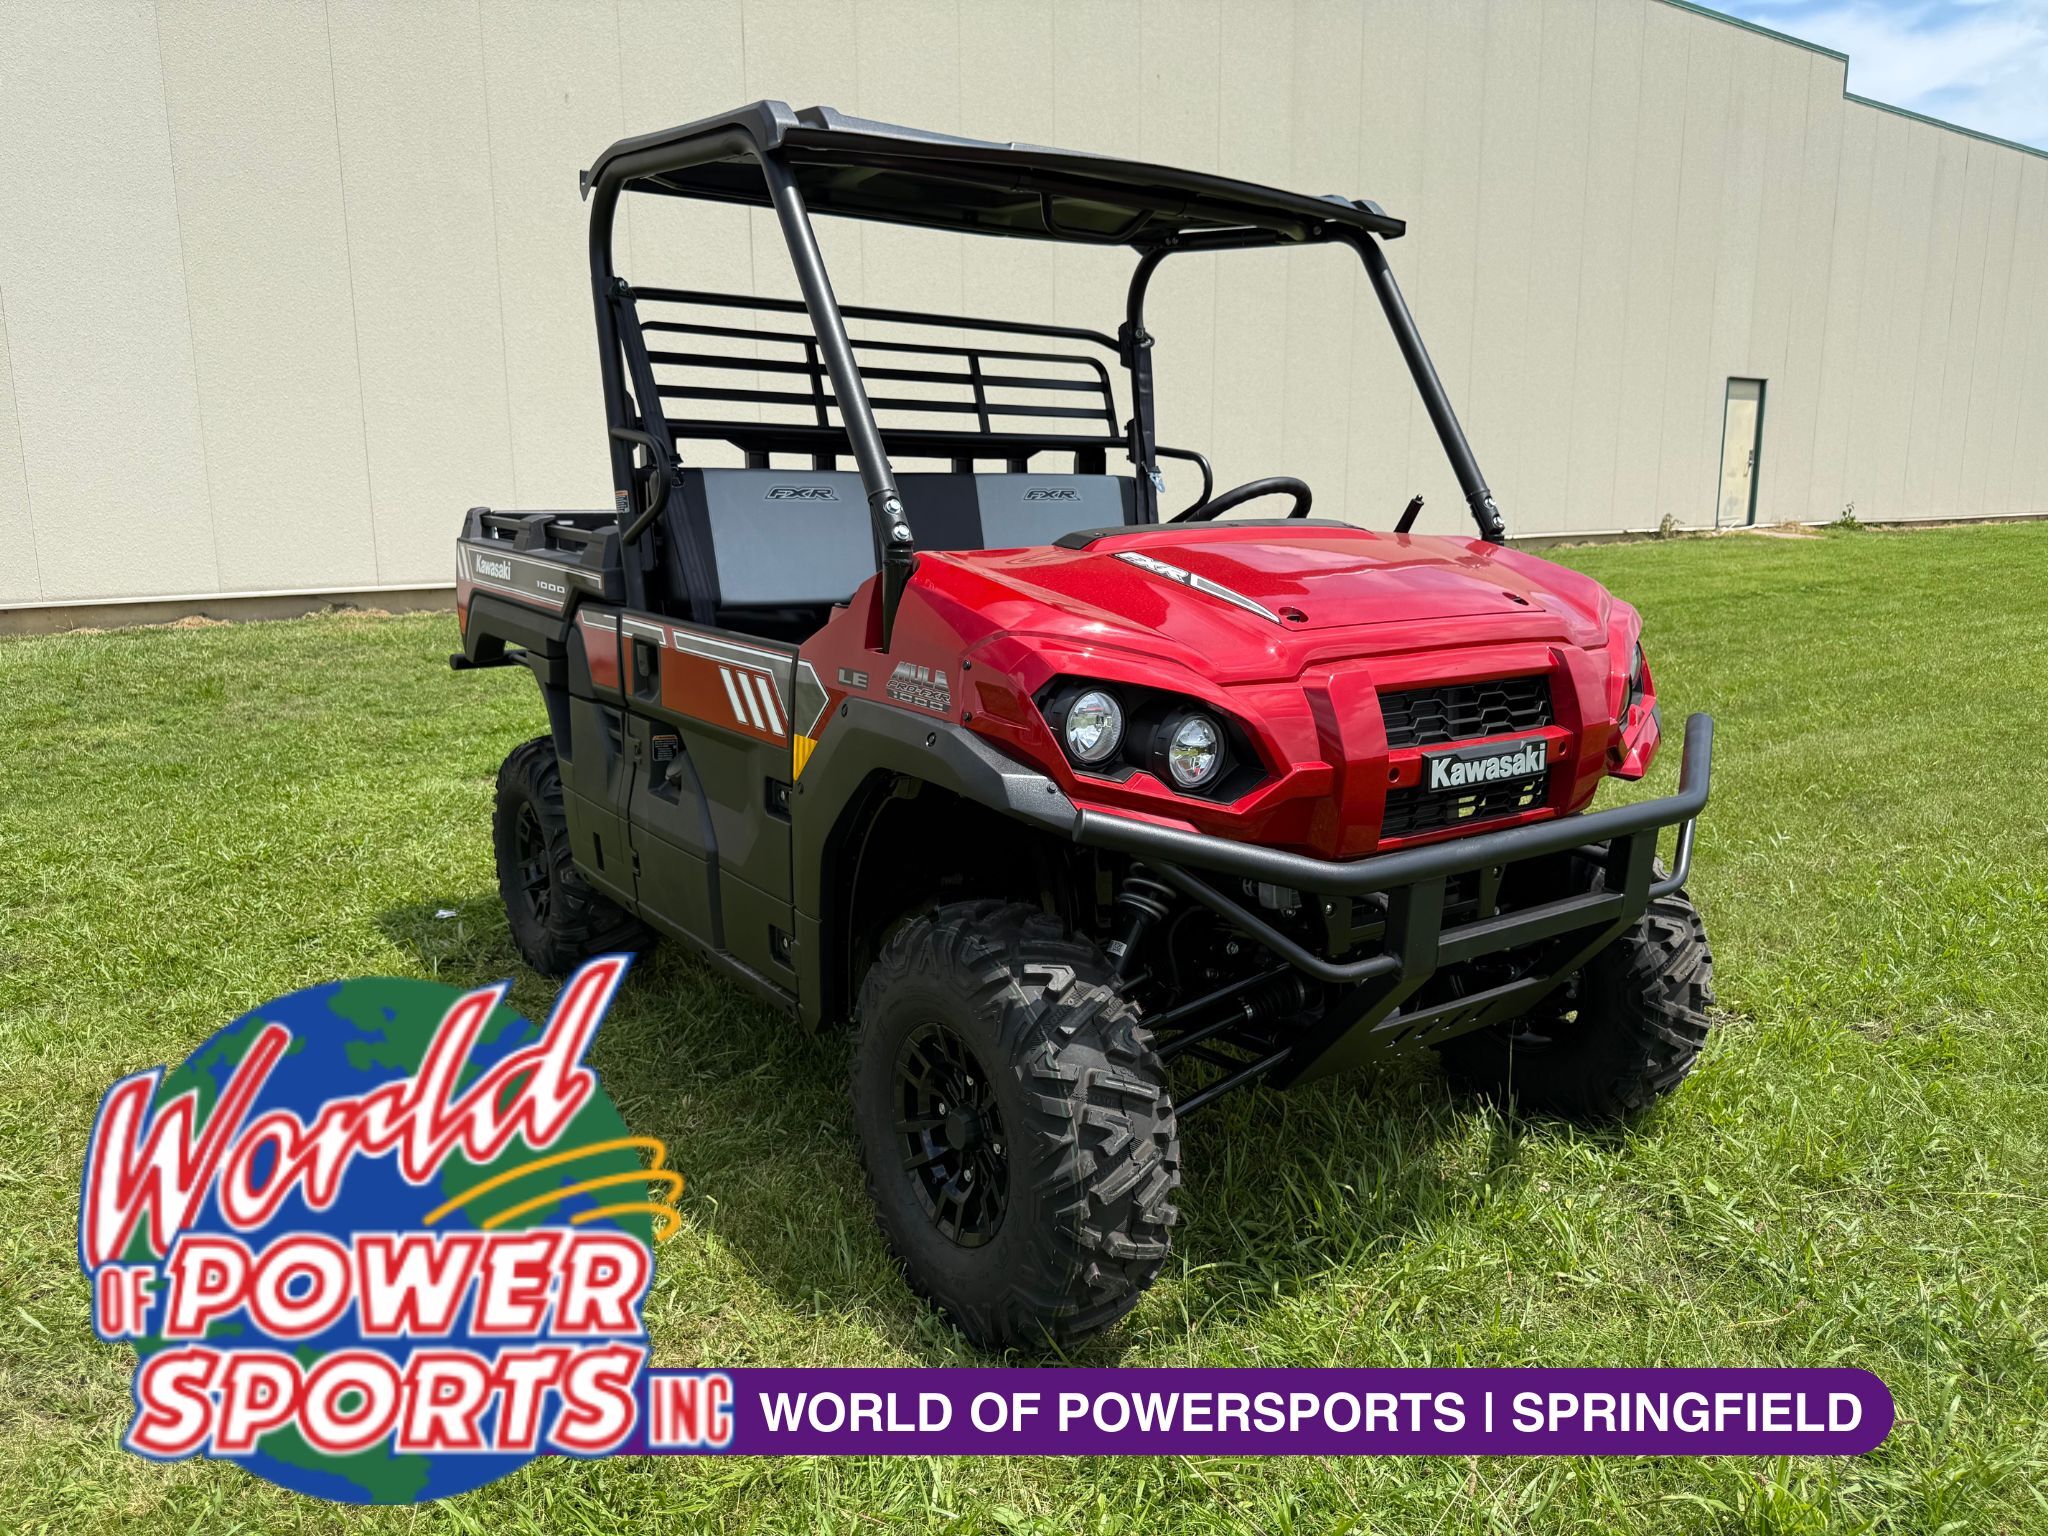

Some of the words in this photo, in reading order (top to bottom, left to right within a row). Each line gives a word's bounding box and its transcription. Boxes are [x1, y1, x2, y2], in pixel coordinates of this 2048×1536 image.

[765, 486, 838, 501] FXR
[1024, 488, 1080, 501] FXR
[475, 554, 511, 580] Kawasaki
[536, 580, 565, 594] 1000
[838, 668, 868, 688] LE
[1431, 742, 1546, 788] Kawasaki
